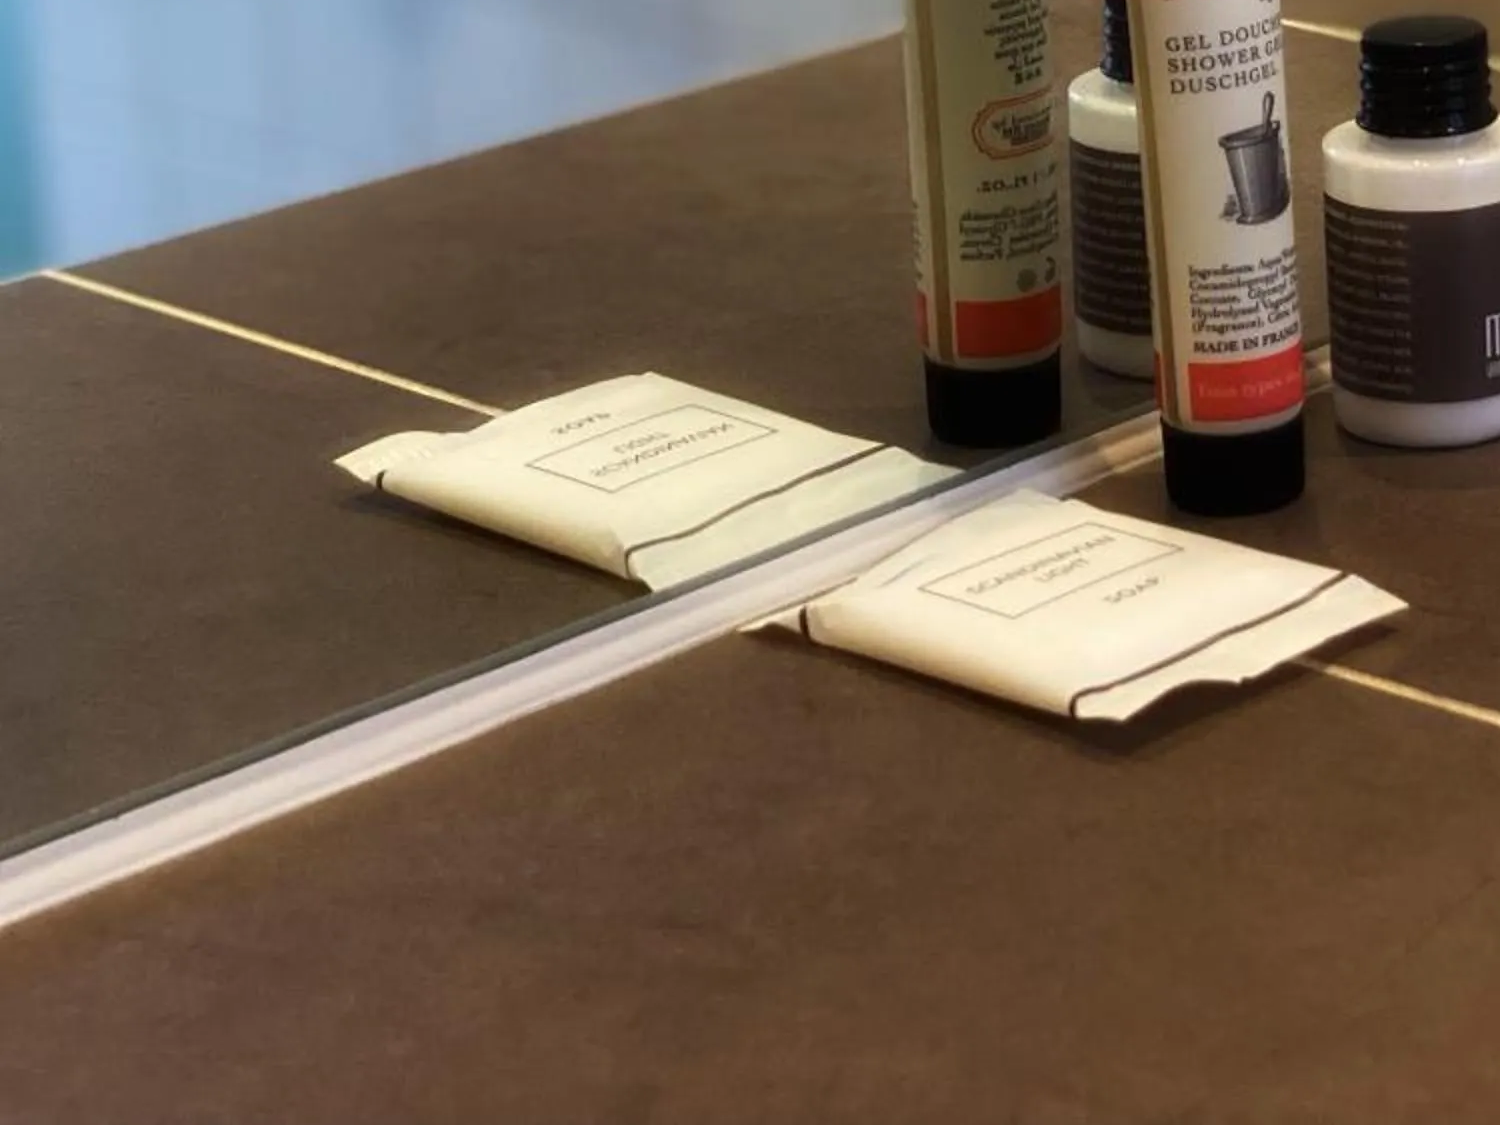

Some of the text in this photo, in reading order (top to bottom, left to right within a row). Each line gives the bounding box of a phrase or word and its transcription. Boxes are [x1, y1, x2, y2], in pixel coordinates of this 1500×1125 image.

[1165, 34, 1212, 53] GEL
[1167, 46, 1260, 74] SHOWER
[1170, 61, 1277, 94] DUSCHGEL
[1193, 339, 1240, 354] MADE
[1242, 335, 1259, 350] IN
[965, 533, 1117, 595] SCANDINAVIAN
[1034, 557, 1090, 583] LIGHT
